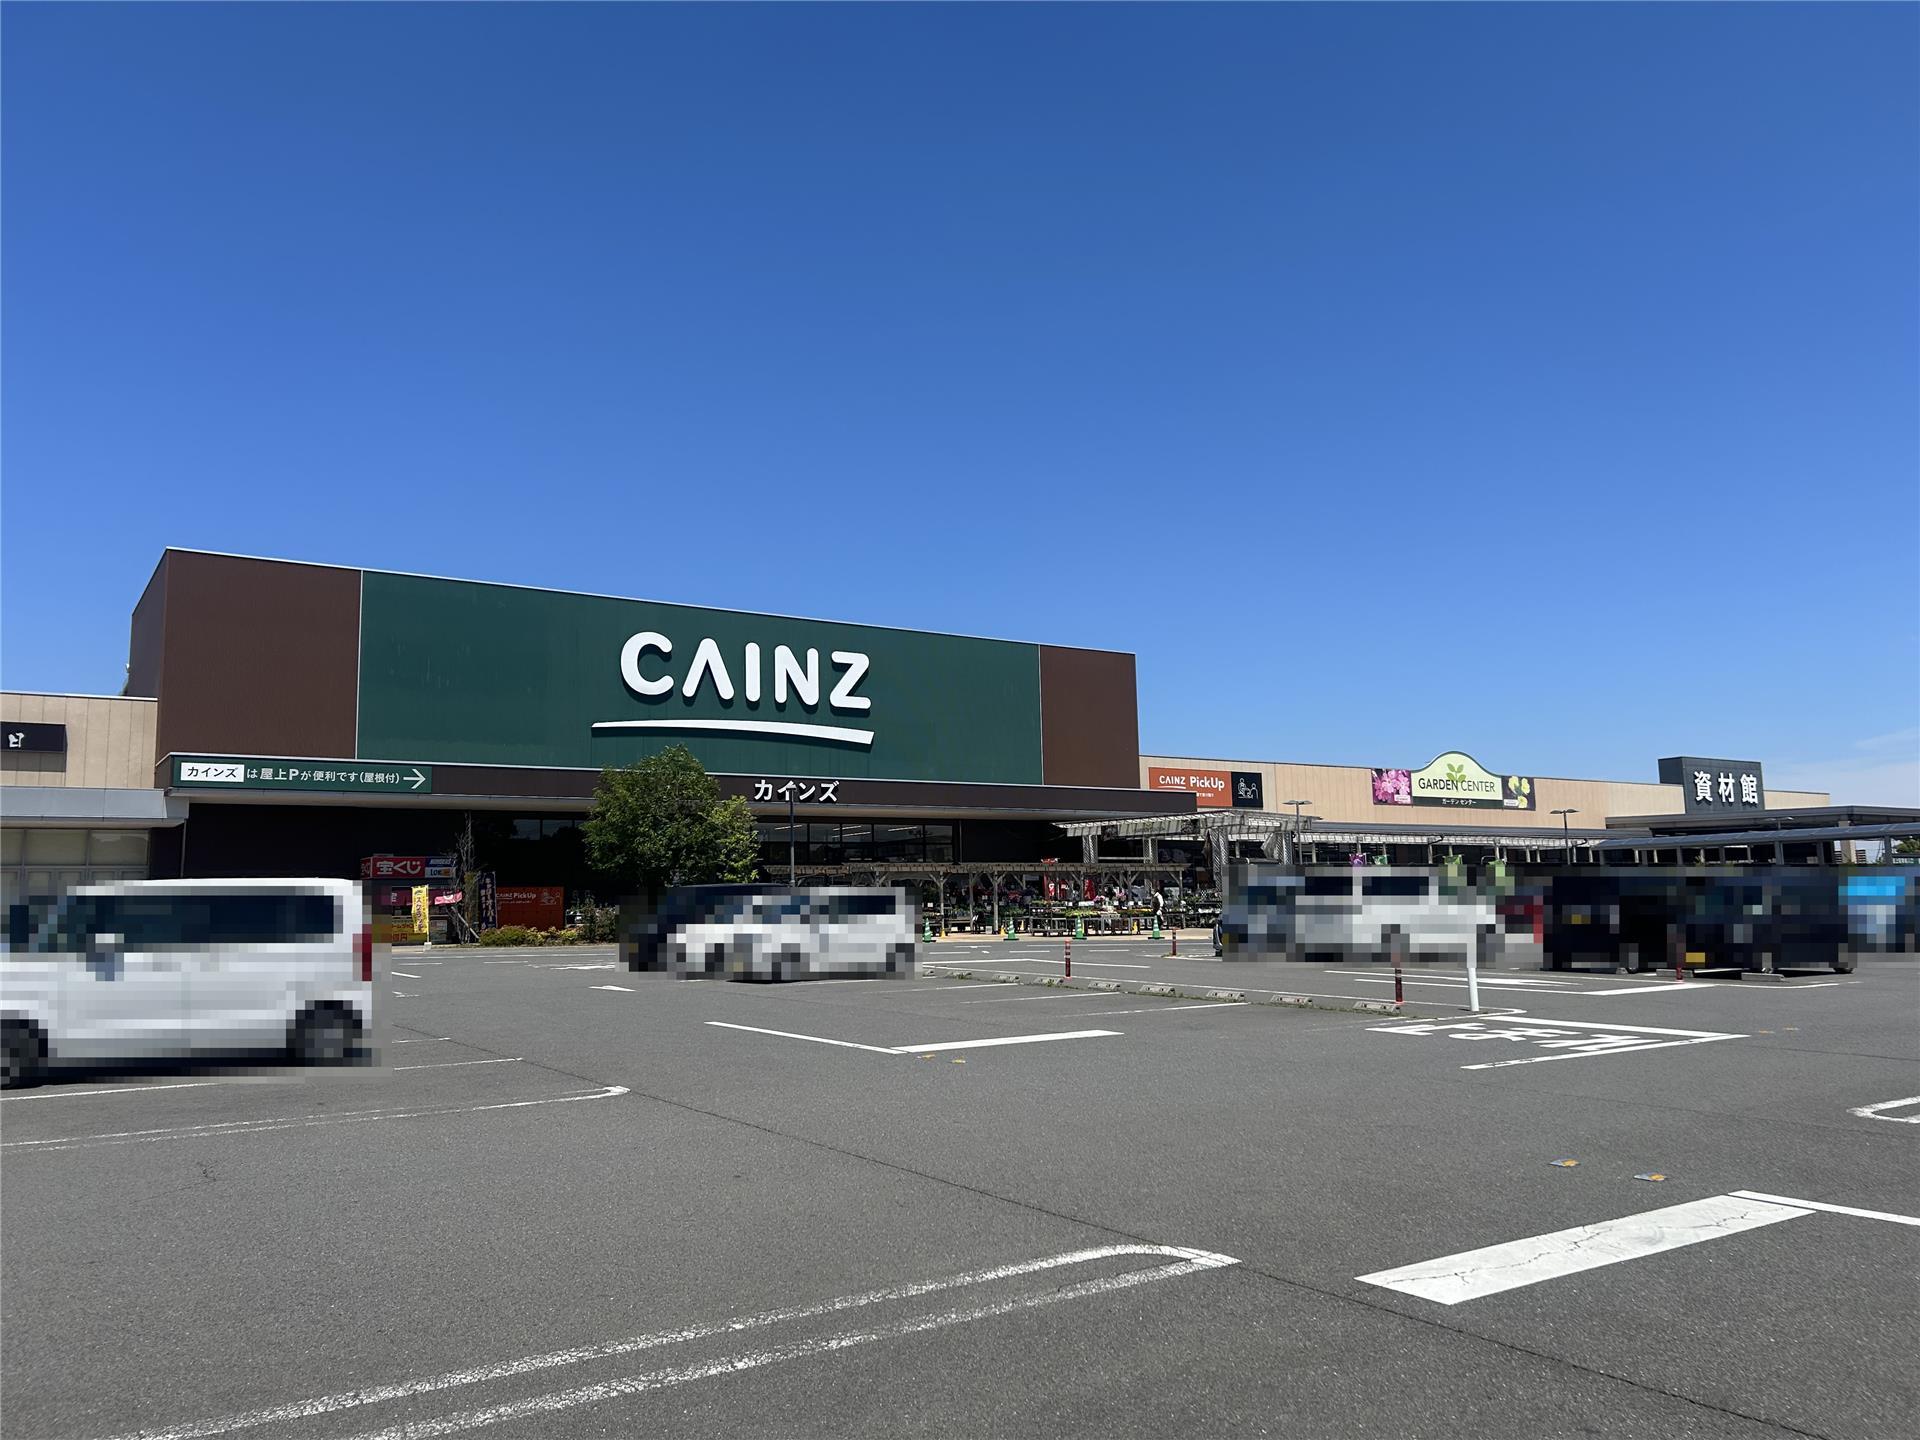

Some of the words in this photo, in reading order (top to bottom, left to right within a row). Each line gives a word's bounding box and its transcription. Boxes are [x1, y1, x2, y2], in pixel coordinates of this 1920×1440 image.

[620, 631, 872, 710] CAINZ
[187, 766, 238, 779] カインズ
[754, 779, 840, 802] カインズ
[1159, 775, 1186, 784] CAINZ
[1190, 776, 1225, 791] PickUp
[1418, 778, 1459, 791] GARDEN
[1460, 781, 1496, 792] CENTER
[1694, 771, 1758, 803] 資材館
[376, 860, 422, 875] 宝くじ
[513, 892, 536, 900] PickUp
